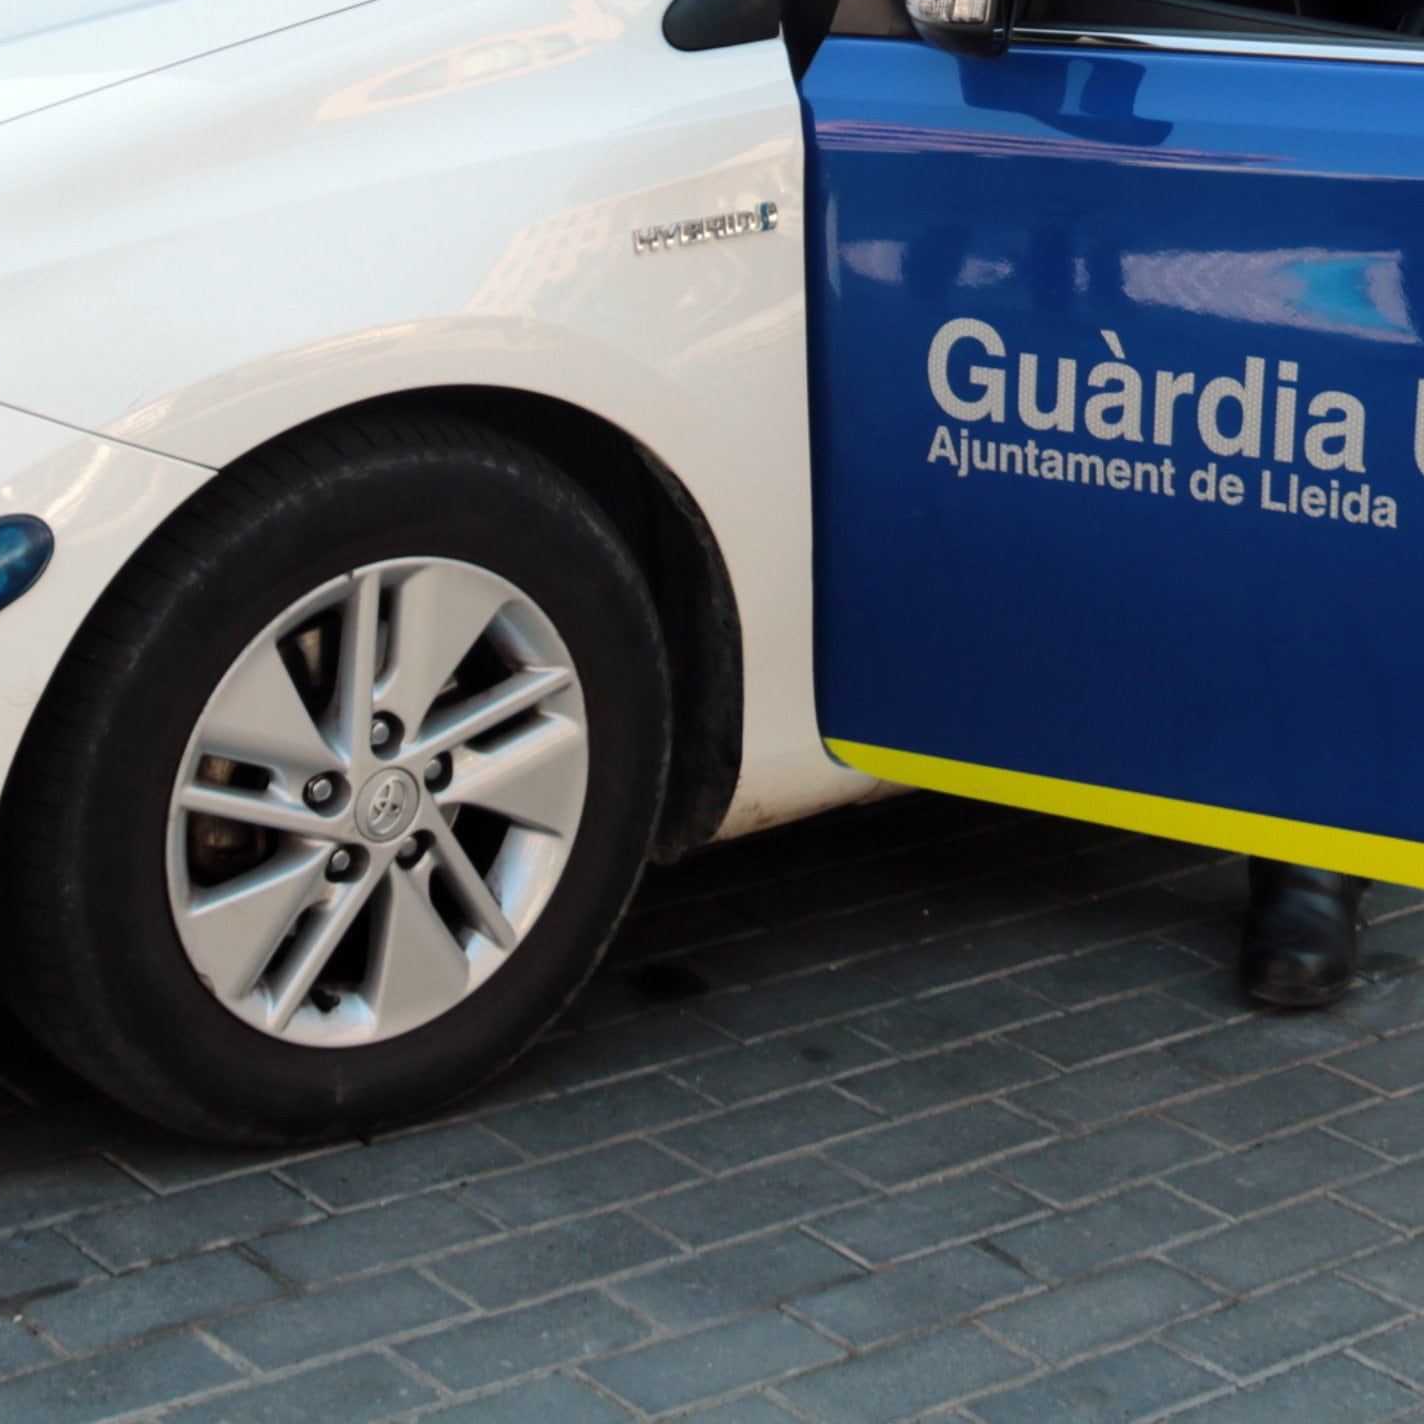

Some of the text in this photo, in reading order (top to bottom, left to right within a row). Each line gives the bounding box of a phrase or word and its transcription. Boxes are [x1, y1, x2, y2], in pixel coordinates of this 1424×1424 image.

[927, 317, 1367, 474] Guàrdia
[927, 425, 1399, 529] Ajuntament de Lleida
